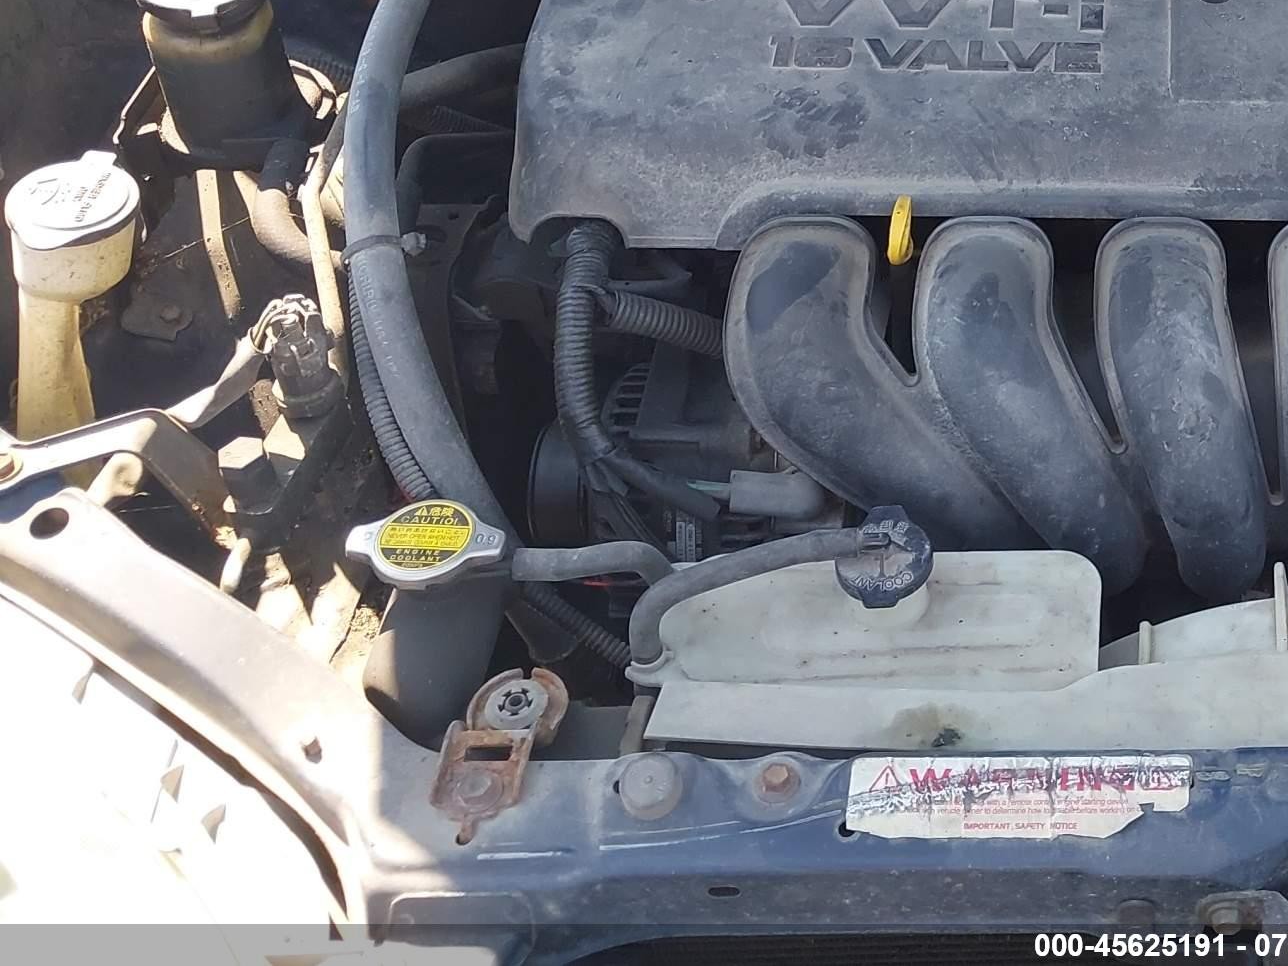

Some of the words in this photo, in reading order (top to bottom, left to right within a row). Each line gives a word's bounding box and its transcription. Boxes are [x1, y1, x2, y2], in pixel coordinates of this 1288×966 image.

[769, 35, 854, 70] 16
[864, 37, 1103, 74] VALVE
[389, 554, 441, 562] COOLANT
[850, 571, 914, 591] COOLANT
[964, 822, 1010, 830] IMPORTANT
[1015, 822, 1045, 830] SAFETY
[1050, 822, 1078, 830] NOTICE
